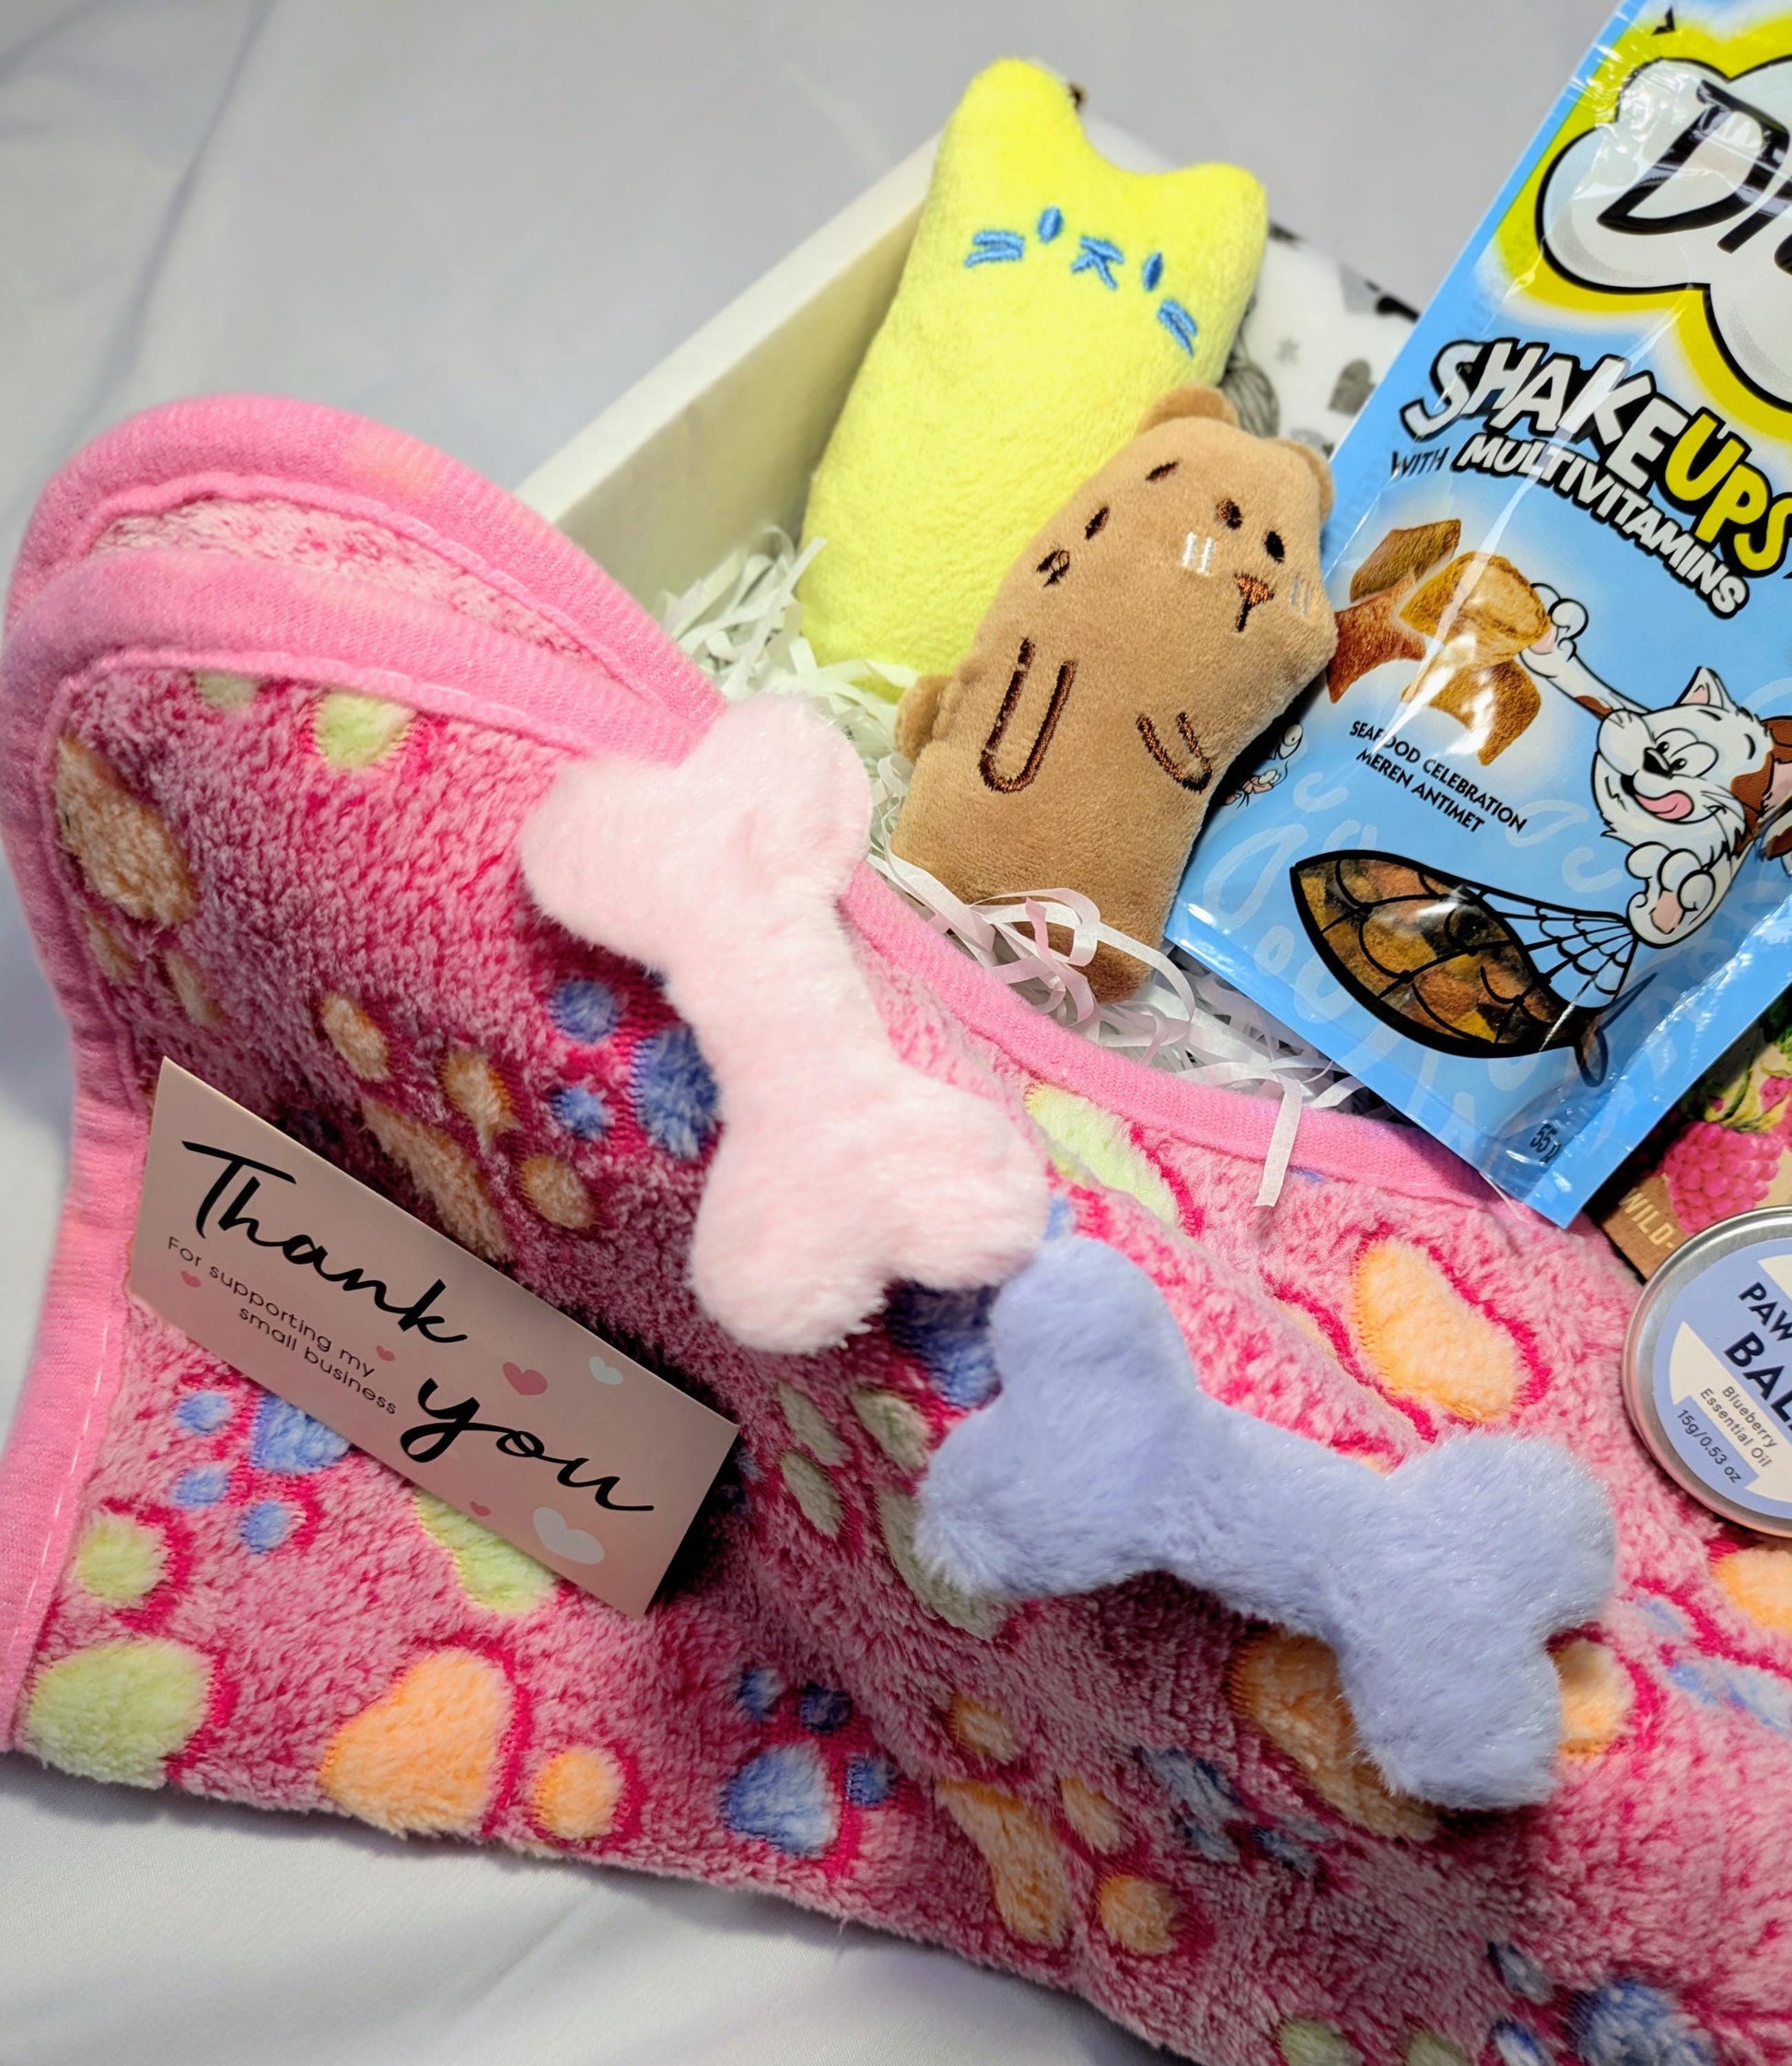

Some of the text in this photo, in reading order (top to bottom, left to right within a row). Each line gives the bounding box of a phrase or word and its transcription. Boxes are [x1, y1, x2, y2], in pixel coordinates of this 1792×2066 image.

[1391, 433, 1748, 615] WITH MULTIVITAMINS
[1356, 748, 1485, 833] MEREN ANTIMET
[1423, 759, 1527, 834] CELEBRATION
[181, 1140, 468, 1343] Thank
[168, 1236, 375, 1378] For supporting my
[1738, 1282, 1792, 1341] PAW
[239, 1307, 396, 1415] small business
[1724, 1331, 1792, 1431] BAL
[400, 1378, 654, 1512] you
[1678, 1409, 1742, 1483] 15g/0.53 oz
[1700, 1388, 1773, 1467] Essential Oil
[1722, 1386, 1778, 1449] Blueberry
